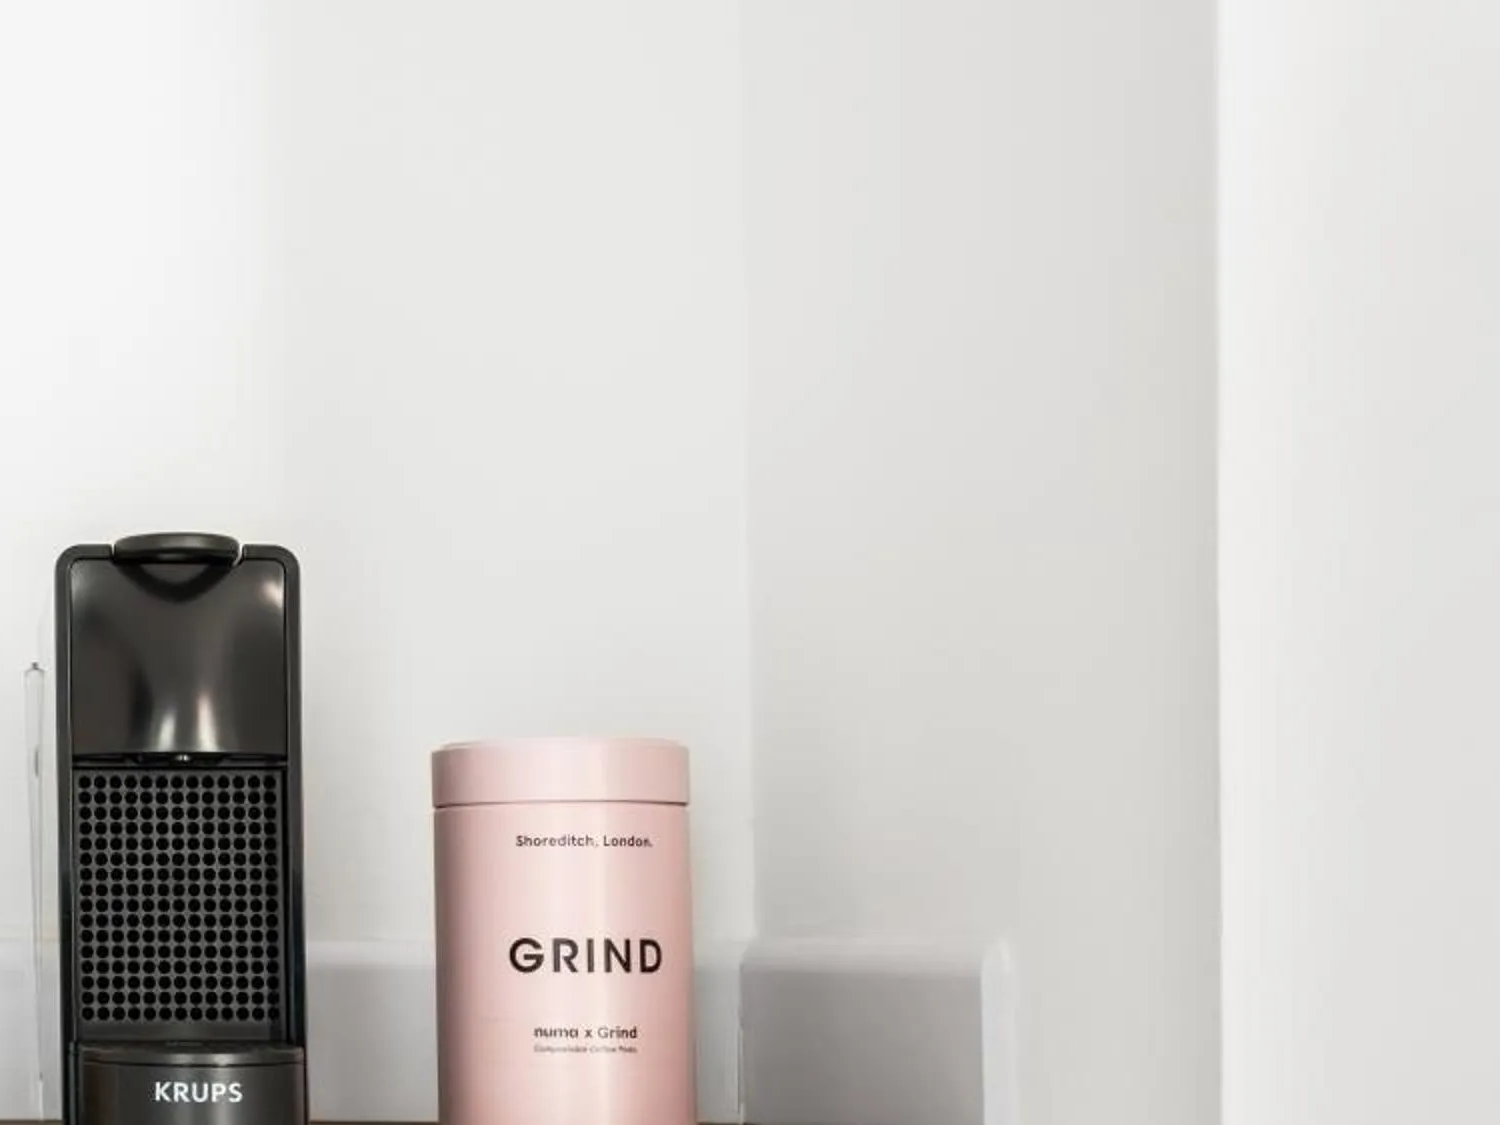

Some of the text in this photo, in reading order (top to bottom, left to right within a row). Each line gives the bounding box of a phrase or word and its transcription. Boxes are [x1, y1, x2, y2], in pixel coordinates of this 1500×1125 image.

[509, 936, 663, 974] GRIND
[534, 1026, 637, 1039] numa x Grind
[155, 1081, 243, 1103] KRUPS
